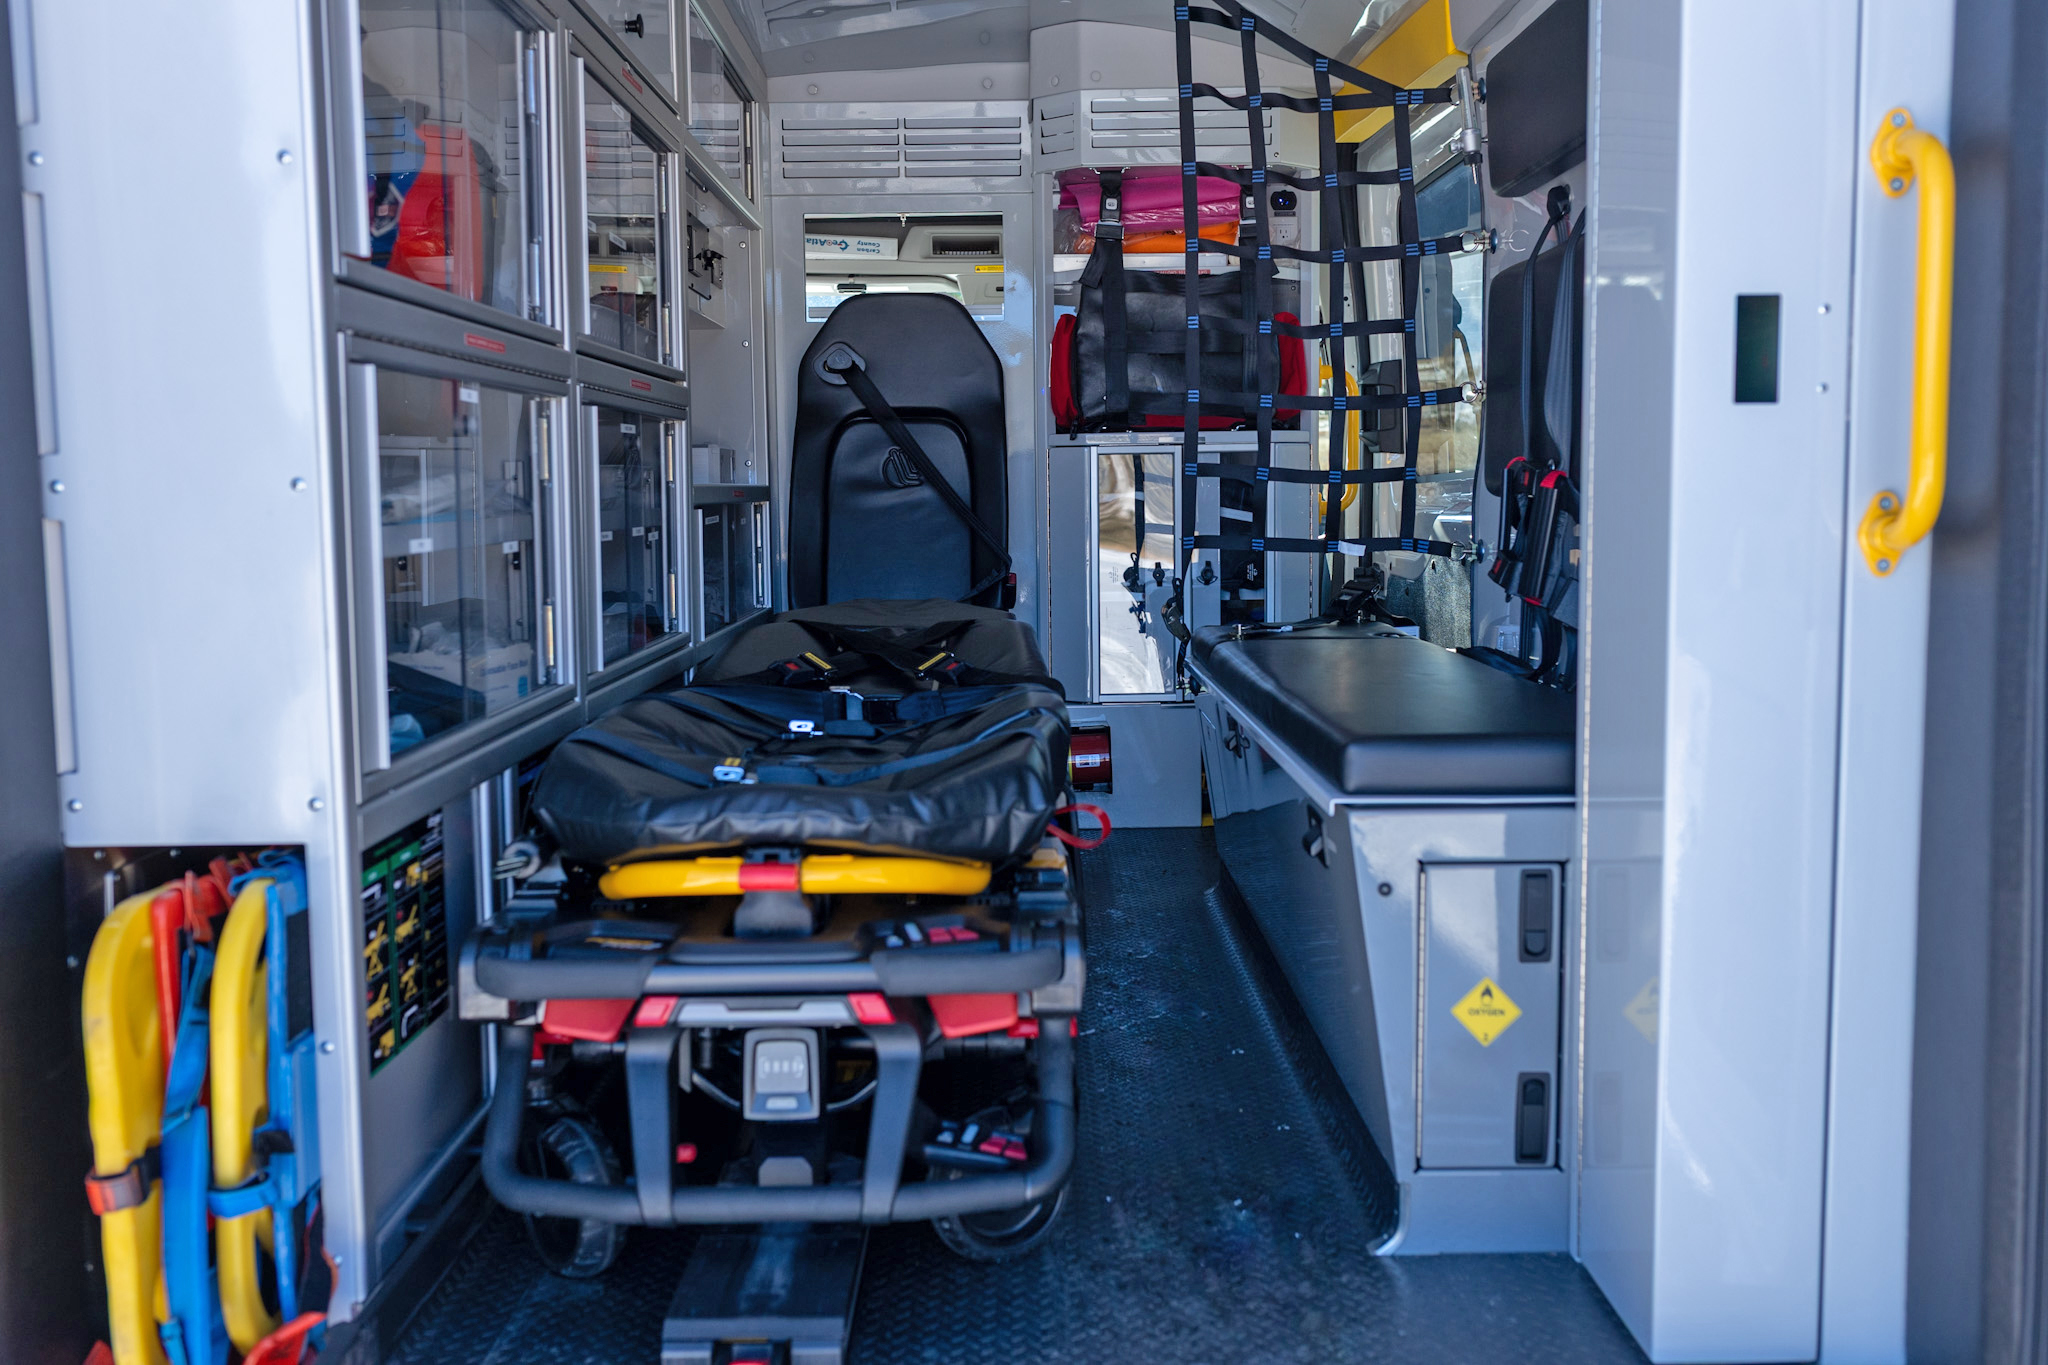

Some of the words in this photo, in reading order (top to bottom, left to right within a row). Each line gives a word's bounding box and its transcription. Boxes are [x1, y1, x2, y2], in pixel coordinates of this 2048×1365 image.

[806, 238, 849, 251] GeoAtla
[857, 240, 880, 248] County
[1467, 1008, 1505, 1016] OXYGEN
